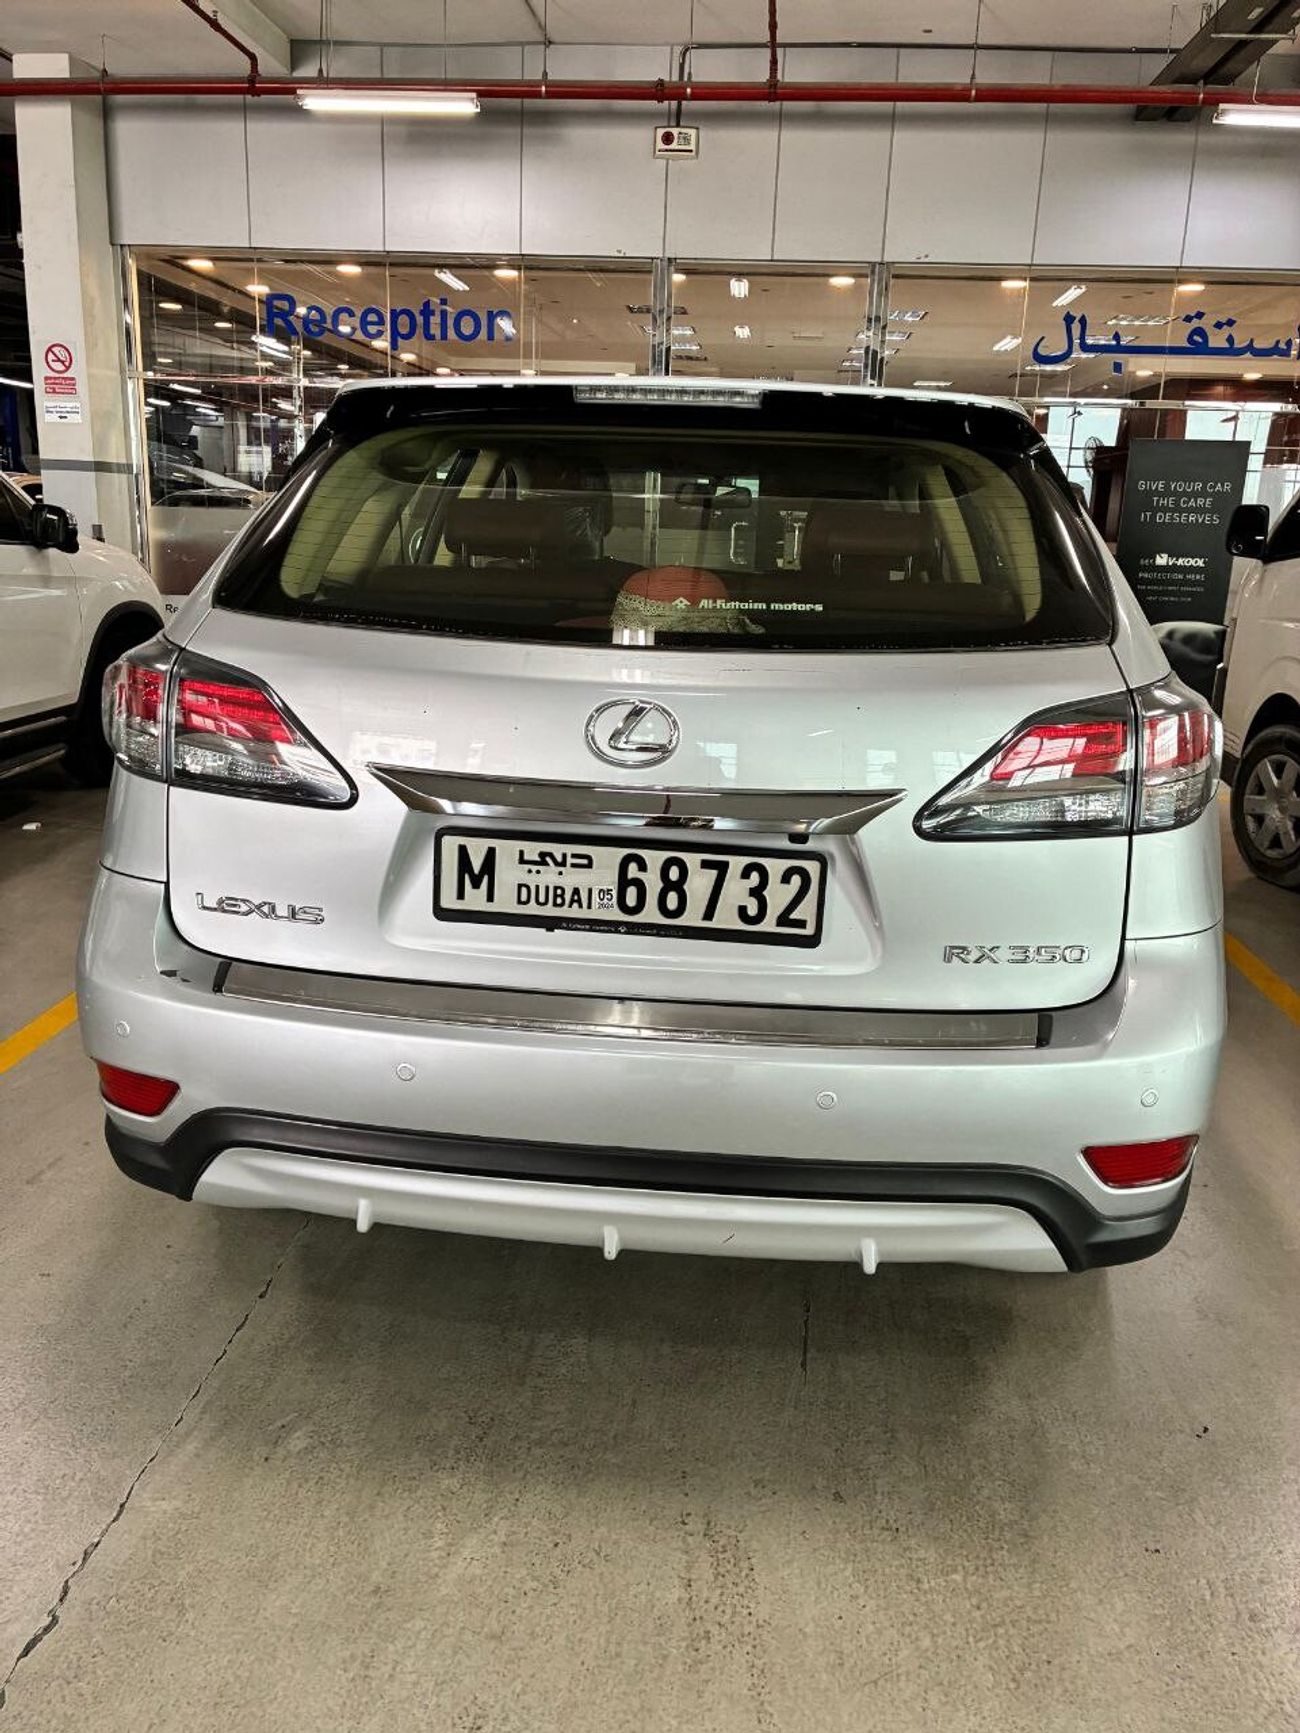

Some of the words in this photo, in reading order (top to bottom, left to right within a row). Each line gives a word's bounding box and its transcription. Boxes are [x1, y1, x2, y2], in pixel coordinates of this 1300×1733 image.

[265, 292, 518, 351] Reception
[1138, 480, 1165, 492] GIVE
[1170, 481, 1203, 492] YOUR
[1207, 482, 1232, 493] CAR
[1153, 497, 1176, 507] THE
[1180, 497, 1214, 508] CARE
[1141, 512, 1152, 522] IT
[1156, 512, 1221, 524] DESERVES
[1168, 556, 1206, 567] V-KOOL
[771, 602, 824, 611] motors
[518, 849, 593, 876] دبي
[455, 843, 497, 903] M
[516, 883, 593, 910] DUBAI
[598, 888, 613, 902] 05
[616, 851, 814, 930] 68732
[195, 892, 325, 924] LEXUS
[943, 945, 1001, 964] RX
[1007, 944, 1091, 964] 350
